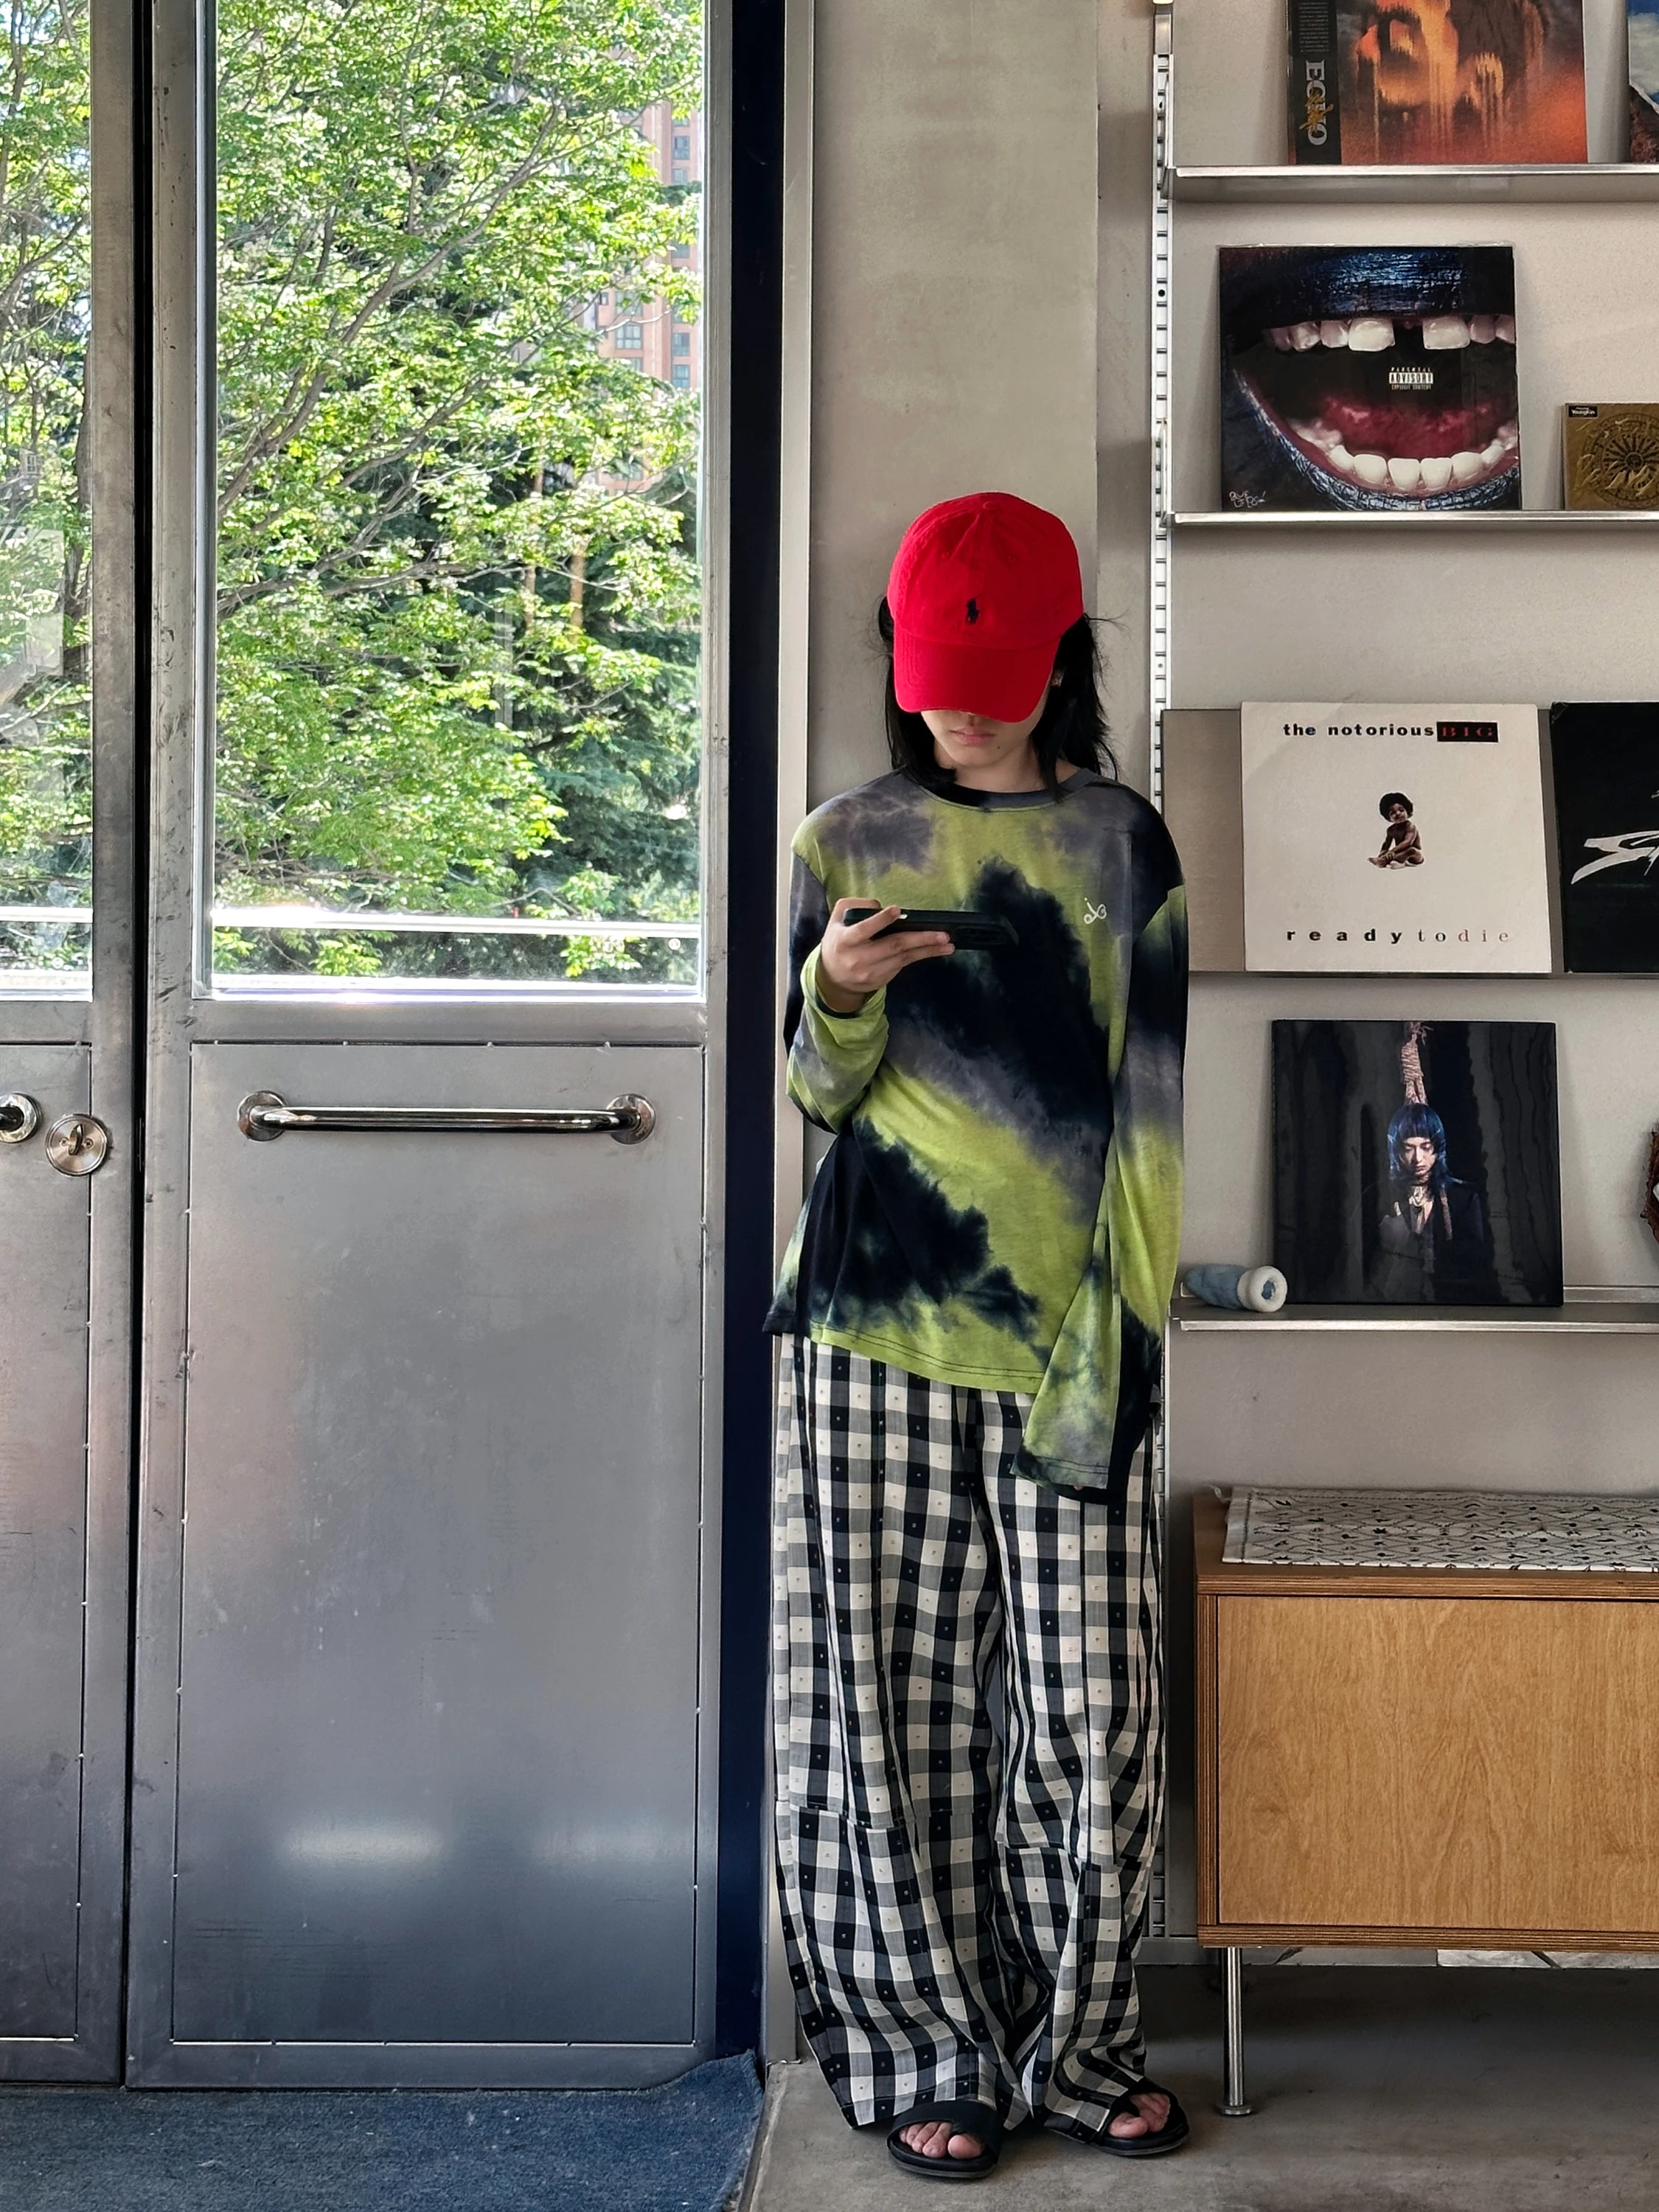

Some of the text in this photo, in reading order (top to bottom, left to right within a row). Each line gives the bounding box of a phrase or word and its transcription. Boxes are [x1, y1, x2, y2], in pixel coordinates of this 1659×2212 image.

[1390, 372, 1433, 383] ADVISORY
[1283, 723, 1316, 736] the
[1328, 723, 1434, 736] notorious
